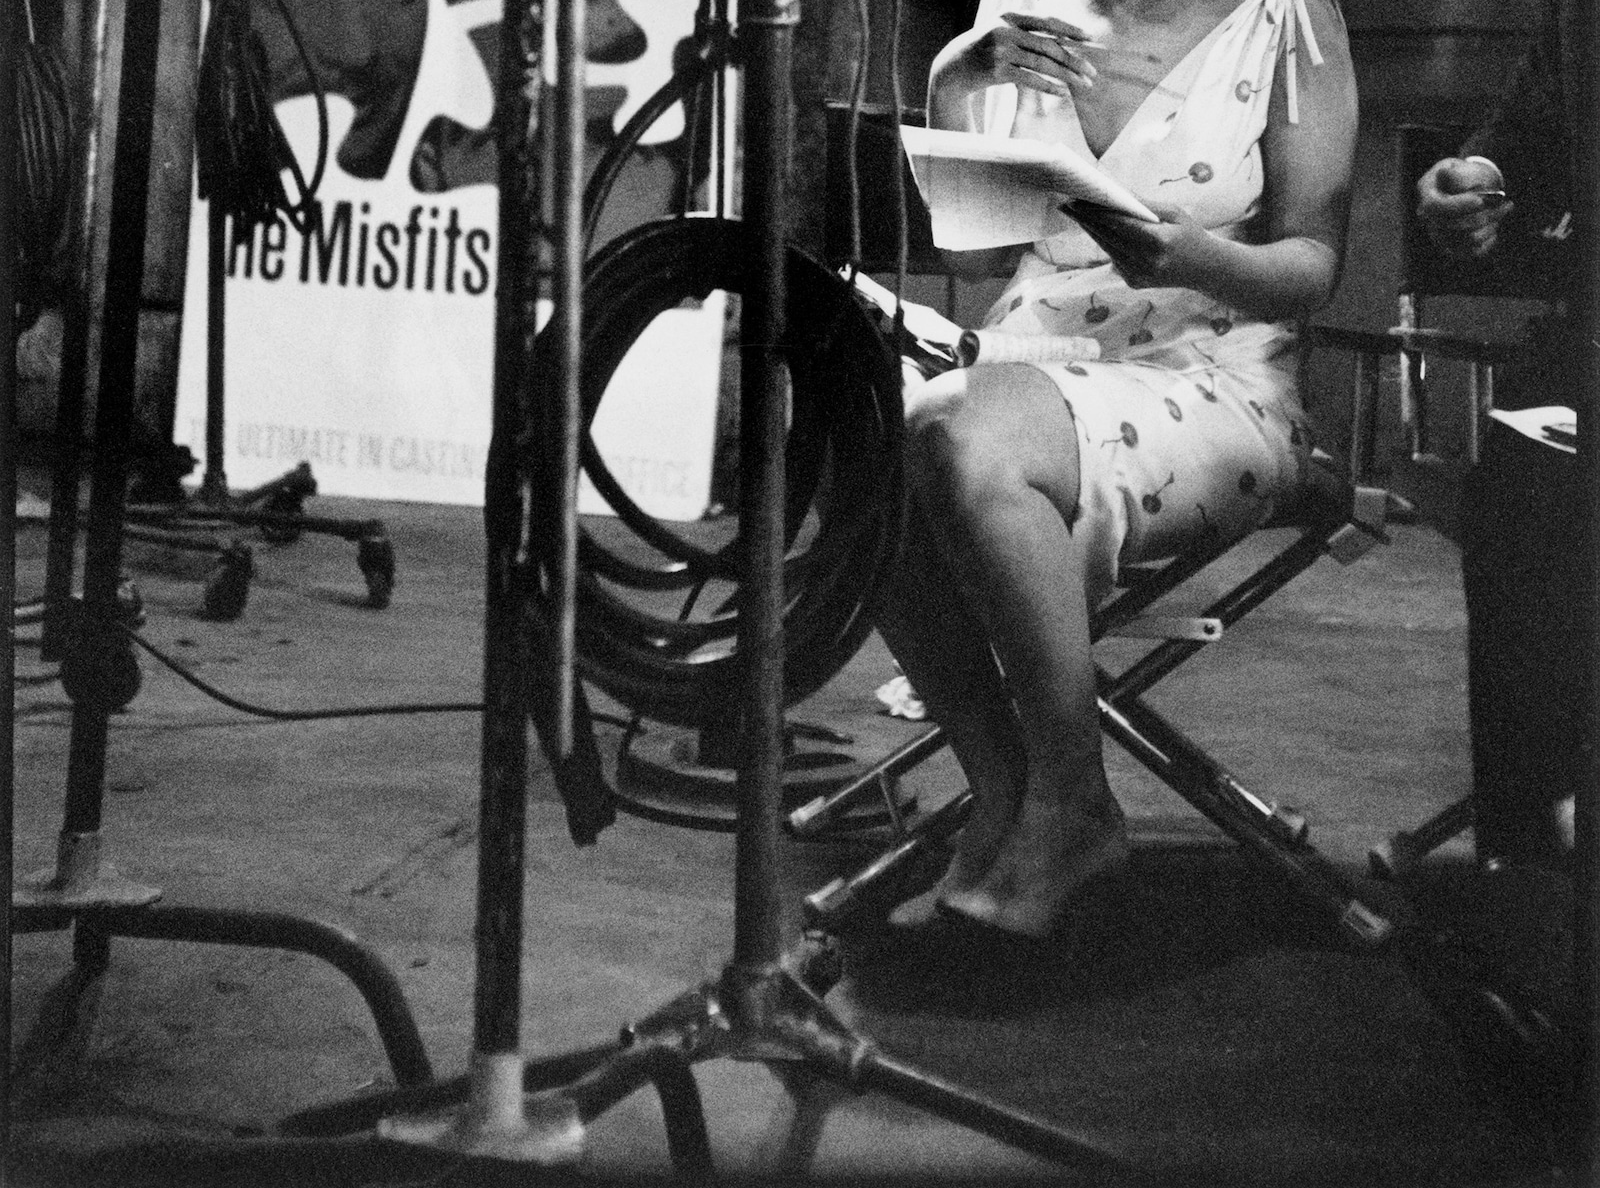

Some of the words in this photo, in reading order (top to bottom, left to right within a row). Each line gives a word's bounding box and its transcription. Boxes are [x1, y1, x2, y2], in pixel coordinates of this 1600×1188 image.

[225, 212, 287, 282] he
[299, 199, 490, 296] Misfits
[237, 422, 349, 468] ULTIMATE
[358, 433, 382, 470] IN
